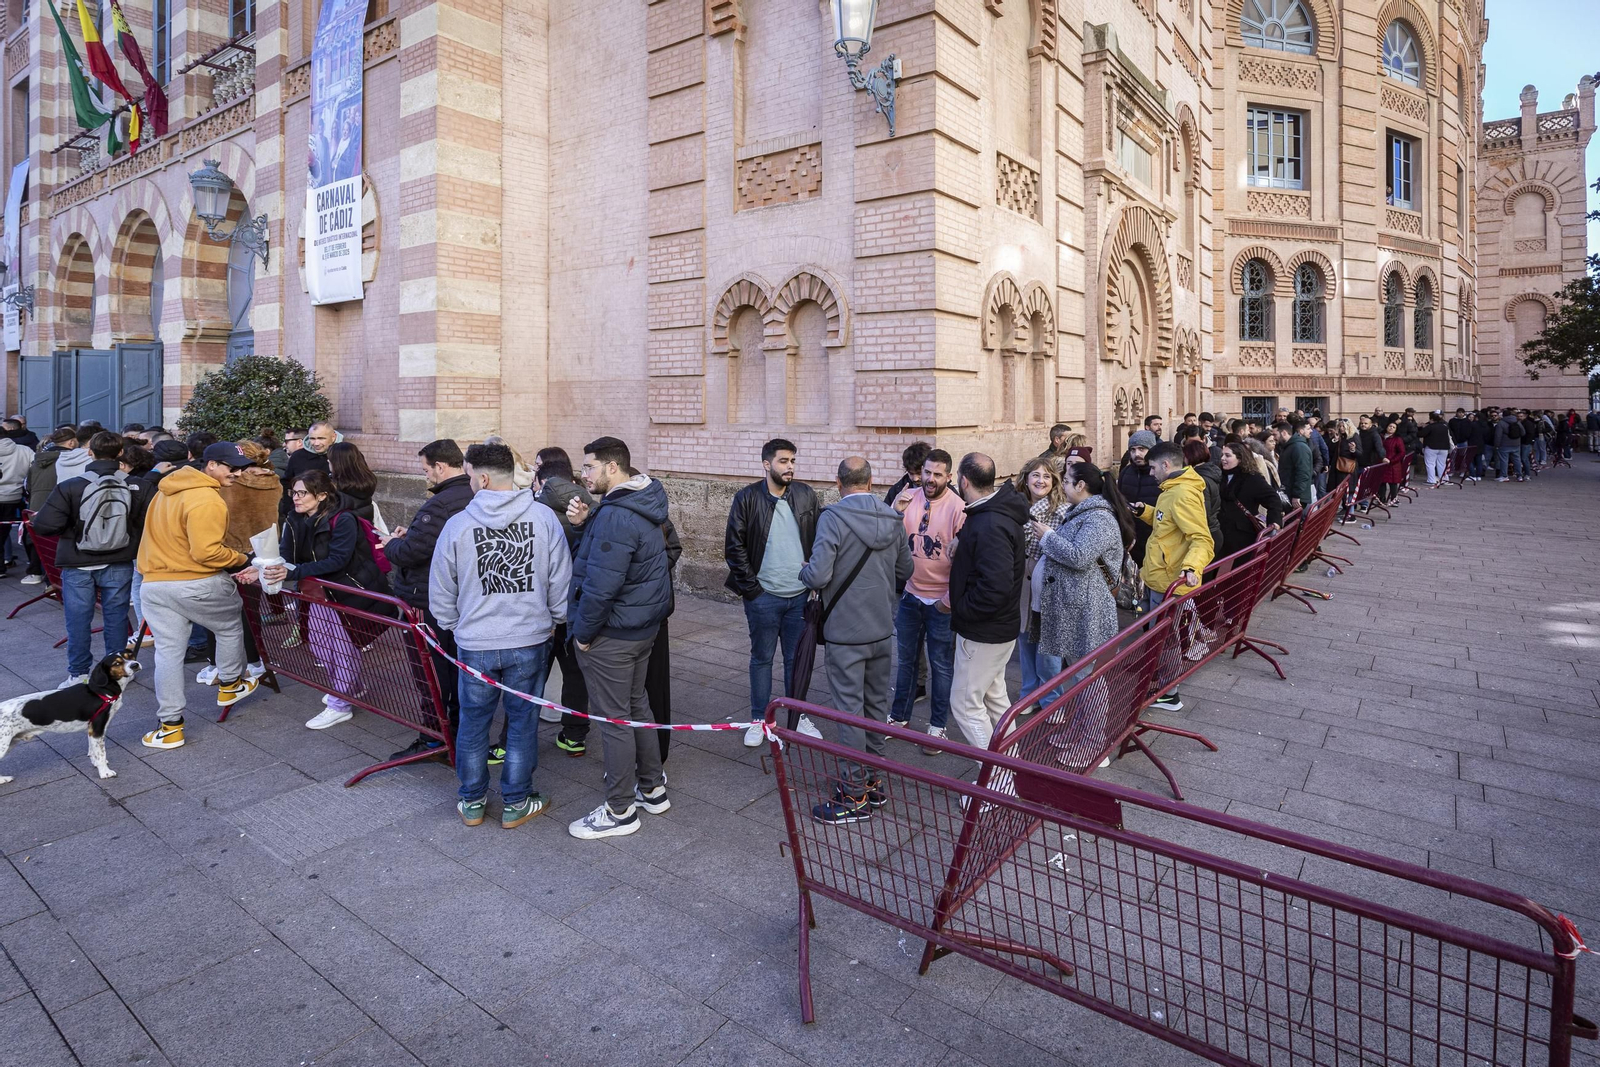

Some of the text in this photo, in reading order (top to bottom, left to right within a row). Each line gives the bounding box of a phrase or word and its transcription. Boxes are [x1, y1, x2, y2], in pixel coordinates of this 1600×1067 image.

[317, 183, 356, 212] CARNAVAL
[320, 207, 353, 235] DE CÁDIZ
[473, 521, 535, 545] BARREL
[476, 539, 535, 567] BARREL
[477, 551, 535, 579] BARREL
[481, 573, 535, 596] BARREL
